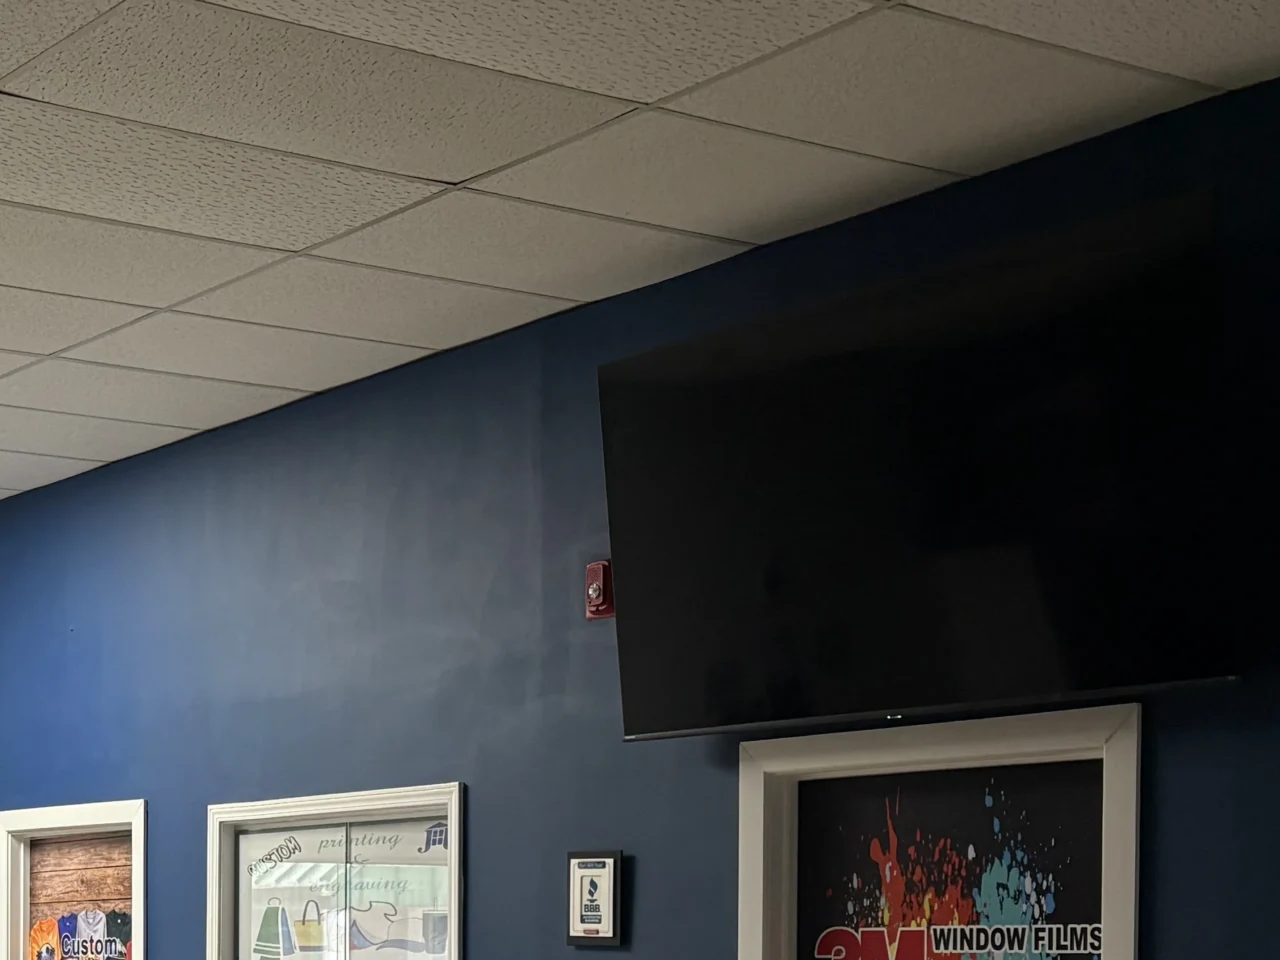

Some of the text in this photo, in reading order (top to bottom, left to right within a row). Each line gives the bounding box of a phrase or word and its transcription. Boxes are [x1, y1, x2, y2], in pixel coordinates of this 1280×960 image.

[247, 835, 302, 878] CUSTOM
[309, 879, 410, 897] engaving
[583, 904, 601, 913] BBB
[61, 933, 118, 957] Custom
[932, 926, 1028, 953] WINDOW
[1032, 925, 1102, 952] FILMS
